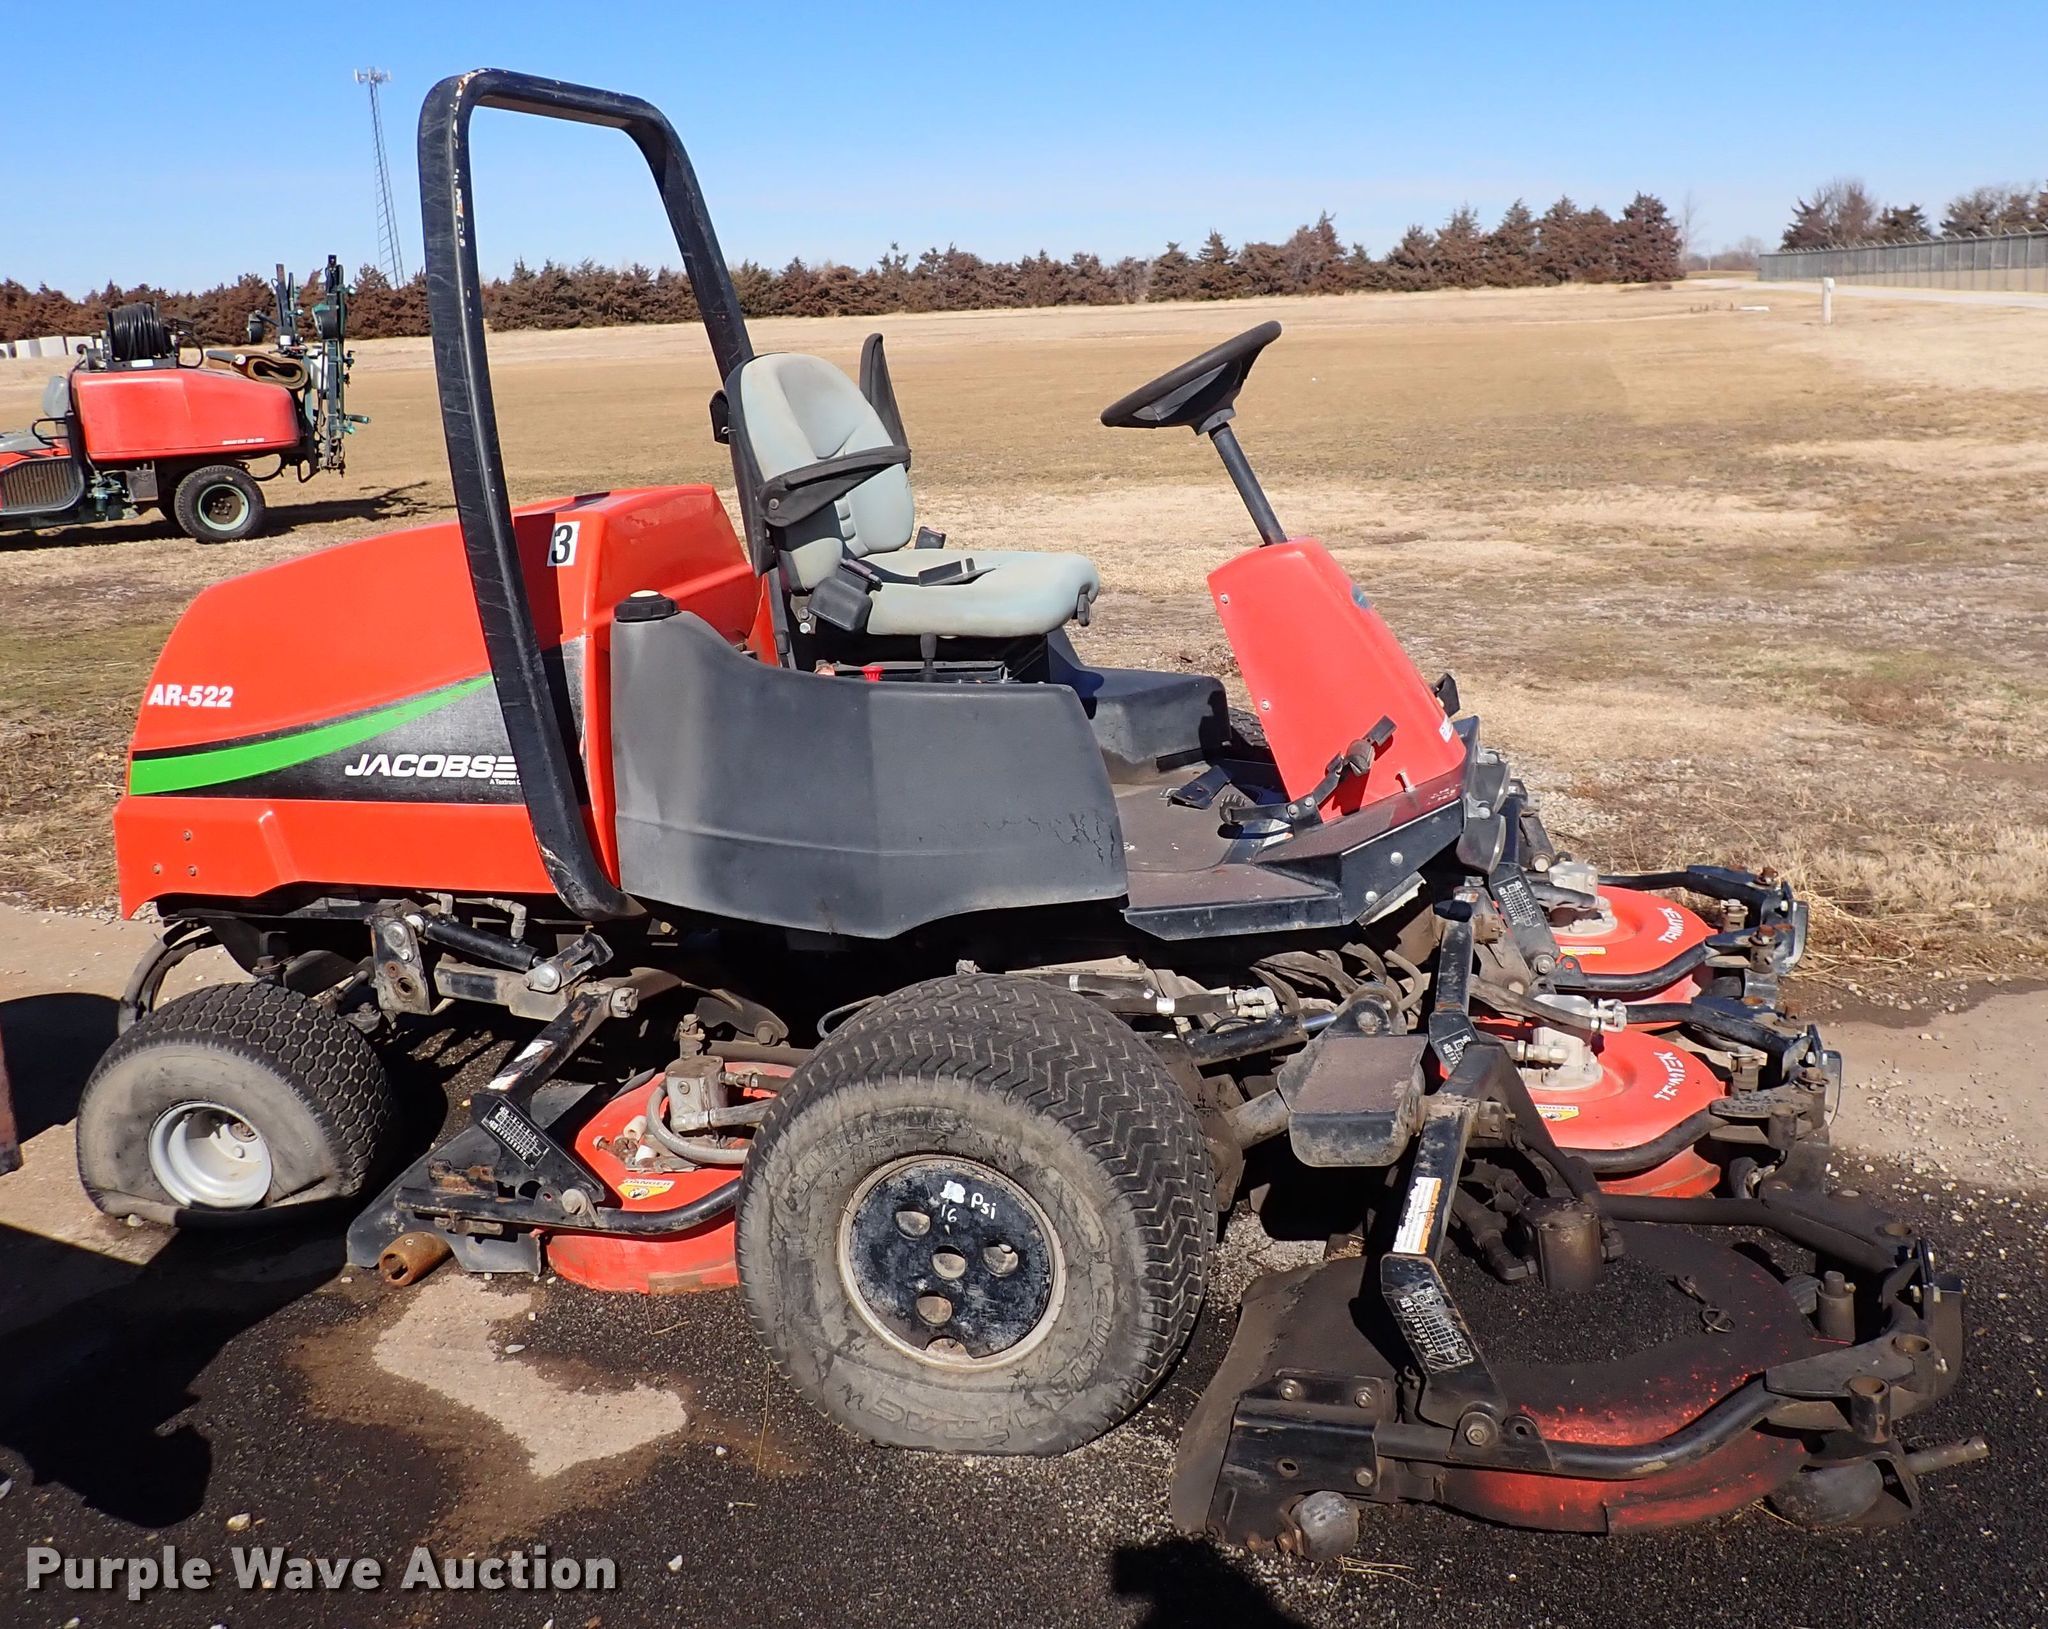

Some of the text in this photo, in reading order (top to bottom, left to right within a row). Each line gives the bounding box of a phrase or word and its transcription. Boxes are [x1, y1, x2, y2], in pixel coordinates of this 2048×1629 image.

[551, 524, 573, 564] 3
[147, 683, 234, 708] AR-522
[344, 753, 519, 779] JACOBSE
[941, 1204, 957, 1223] 16
